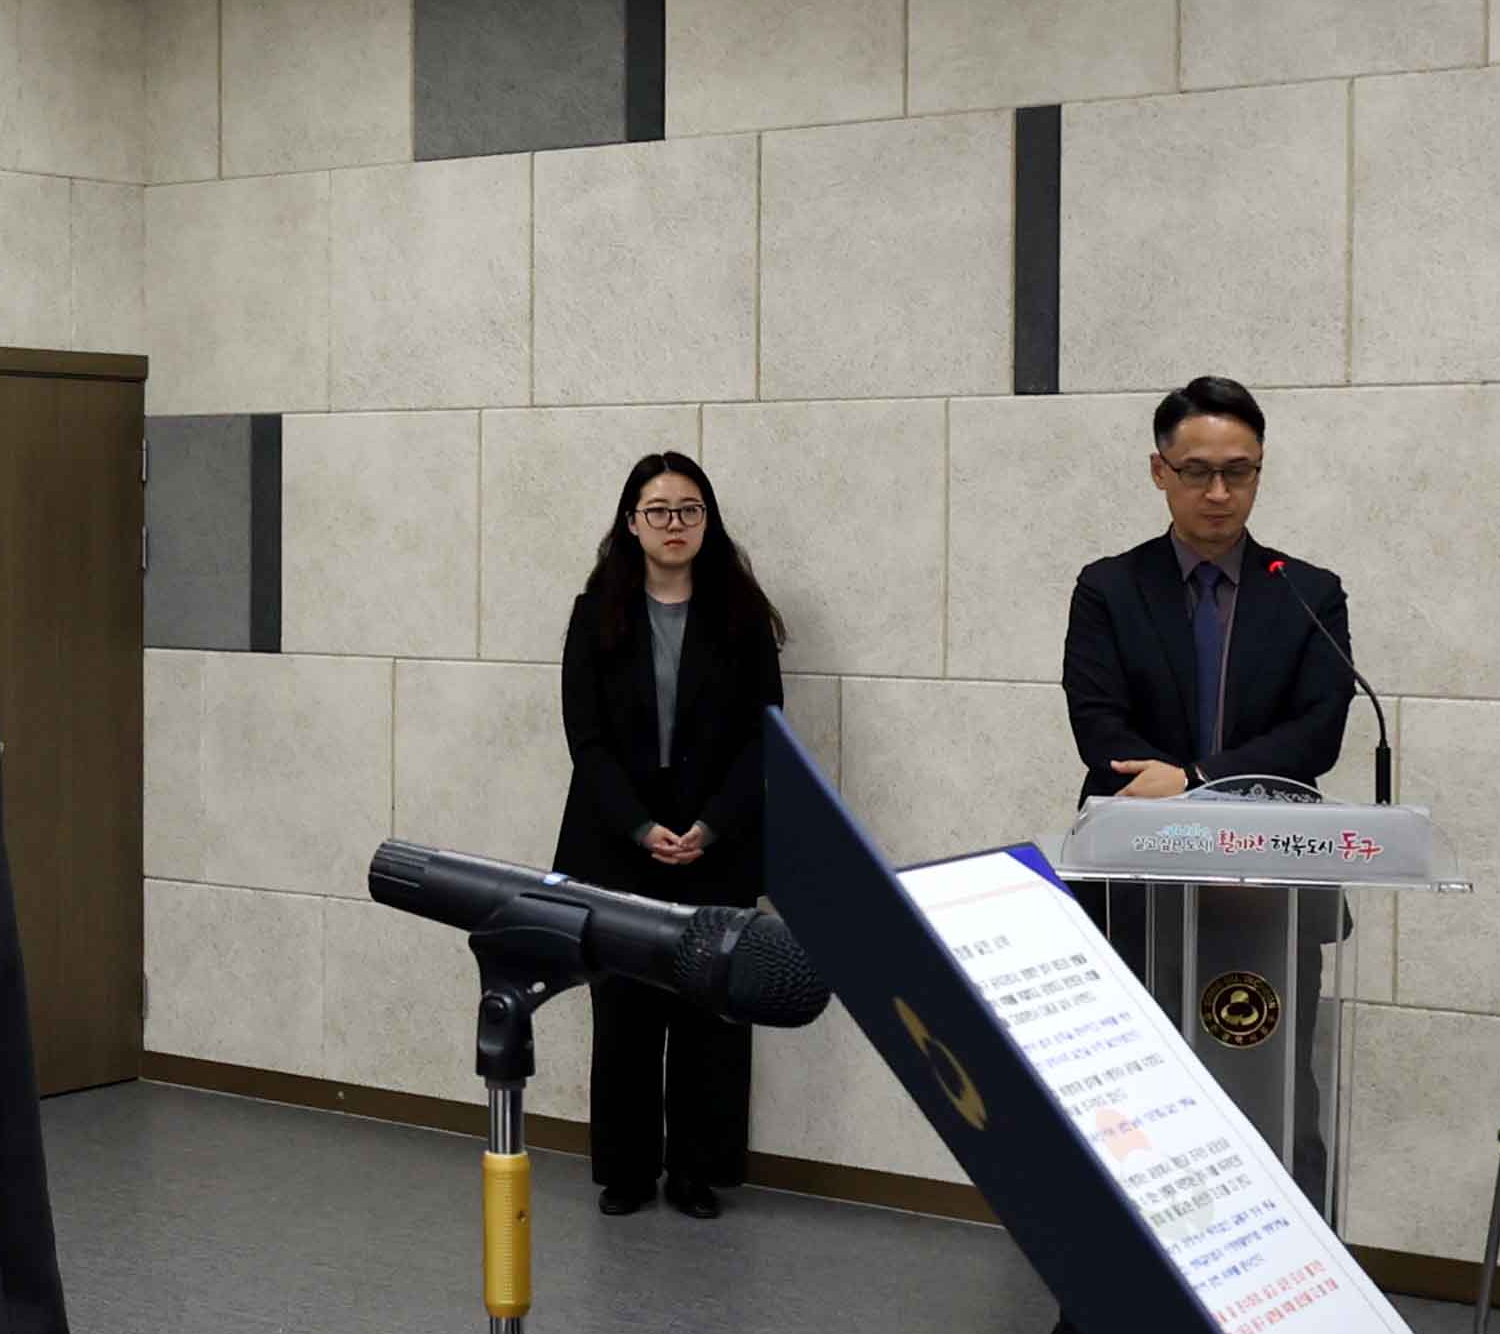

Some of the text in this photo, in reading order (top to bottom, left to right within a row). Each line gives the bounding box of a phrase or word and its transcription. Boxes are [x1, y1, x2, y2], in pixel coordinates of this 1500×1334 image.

[1218, 828, 1265, 854] 활기찬
[1270, 833, 1334, 858] 행복도시
[1336, 830, 1383, 860] 동구
